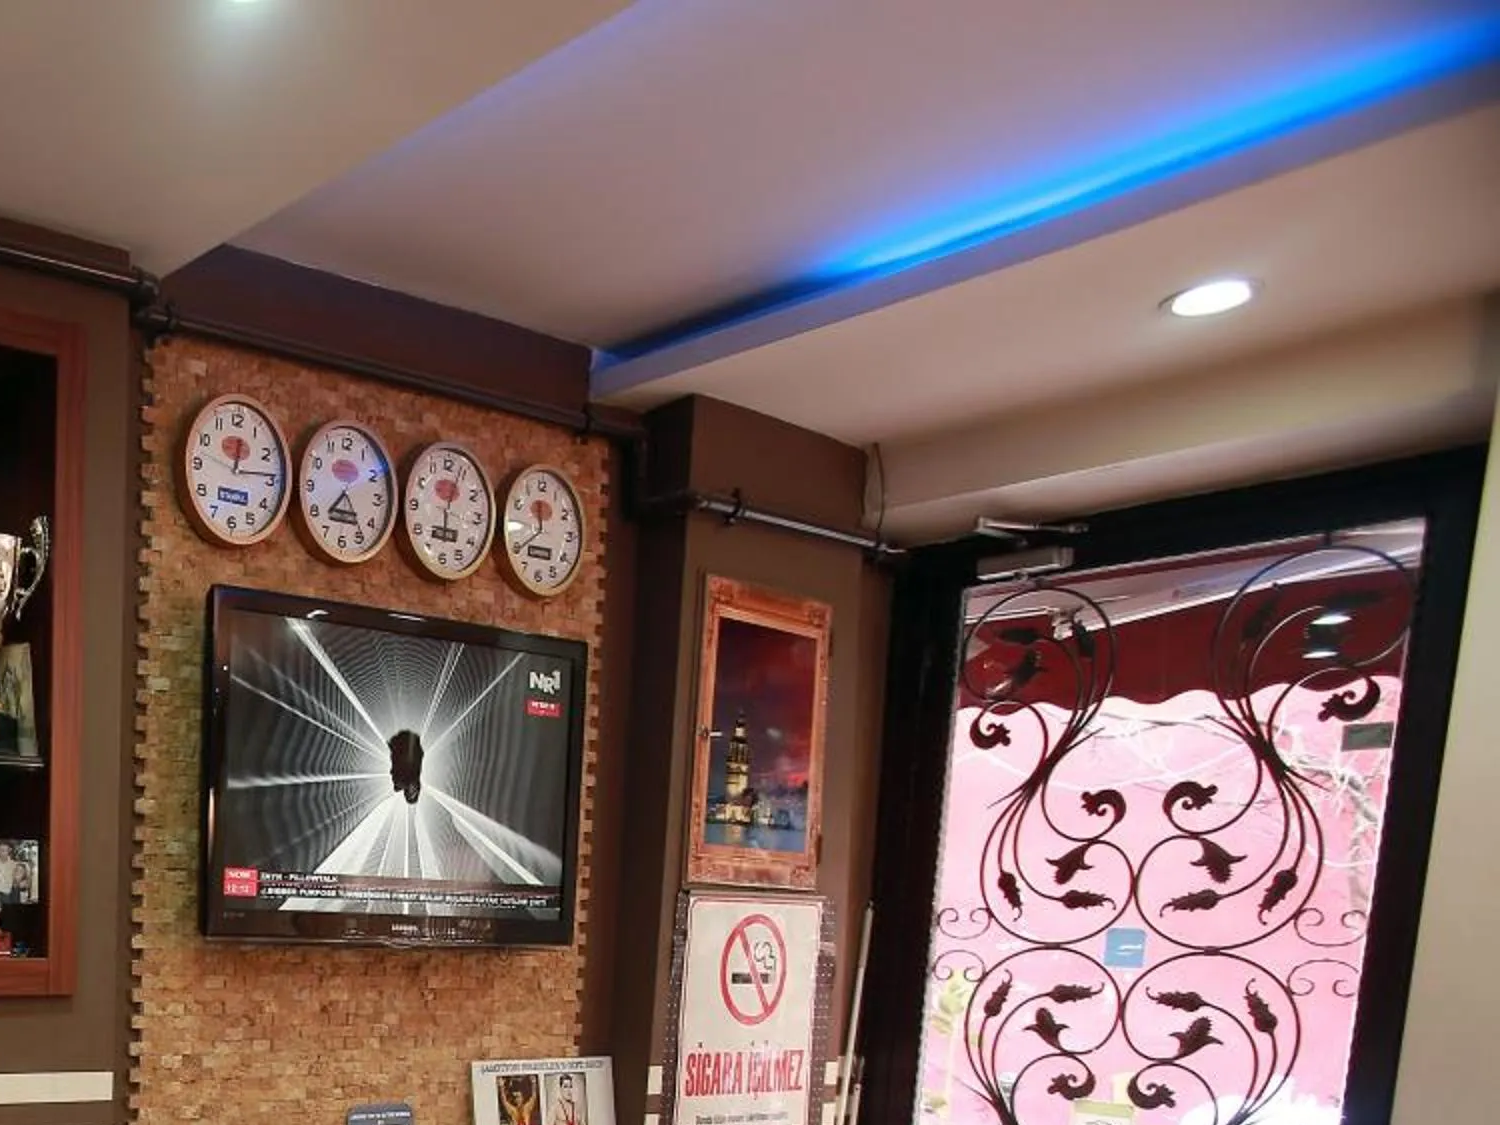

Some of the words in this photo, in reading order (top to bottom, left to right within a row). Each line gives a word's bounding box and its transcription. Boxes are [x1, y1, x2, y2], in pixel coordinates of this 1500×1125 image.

[231, 414, 244, 428] 12
[200, 434, 211, 447] 10
[261, 447, 271, 462] 2
[193, 457, 203, 471] 9
[369, 469, 378, 483] 2
[196, 484, 207, 497] 8
[306, 479, 315, 492] 9
[259, 497, 268, 510] 4
[209, 505, 219, 518] 7
[310, 504, 320, 517] 8
[227, 516, 237, 529] 6
[245, 512, 255, 526] 5
[322, 525, 331, 538] 7
[337, 535, 347, 549] 6
